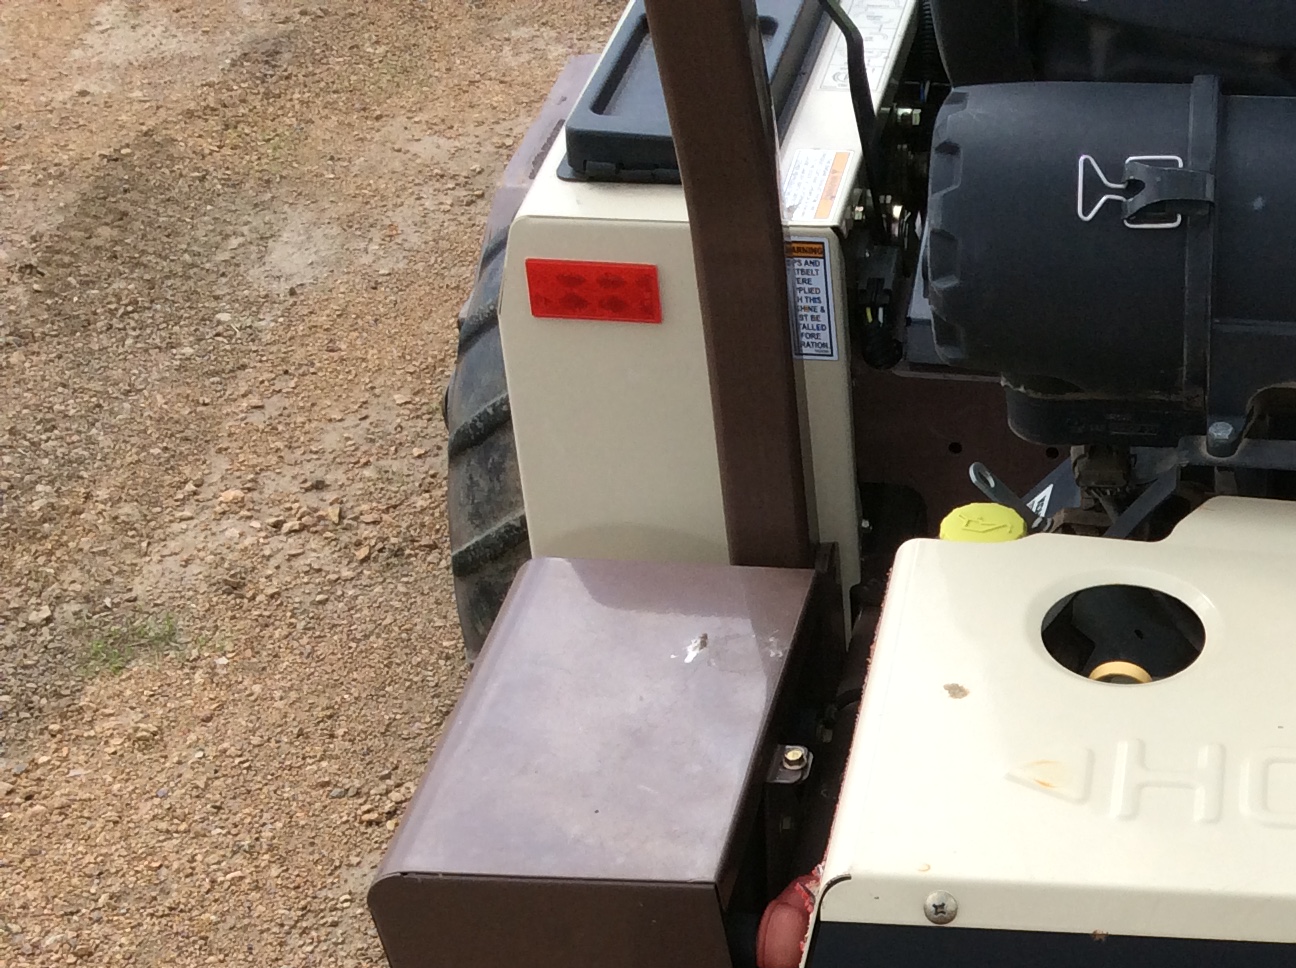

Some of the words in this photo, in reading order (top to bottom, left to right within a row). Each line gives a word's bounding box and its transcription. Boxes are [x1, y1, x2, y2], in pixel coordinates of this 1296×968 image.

[792, 245, 823, 255] ARNING
[804, 259, 821, 267] AND
[795, 268, 820, 276] TBELT
[796, 277, 813, 285] ERE
[805, 296, 822, 304] THIS
[811, 314, 821, 322] BE
